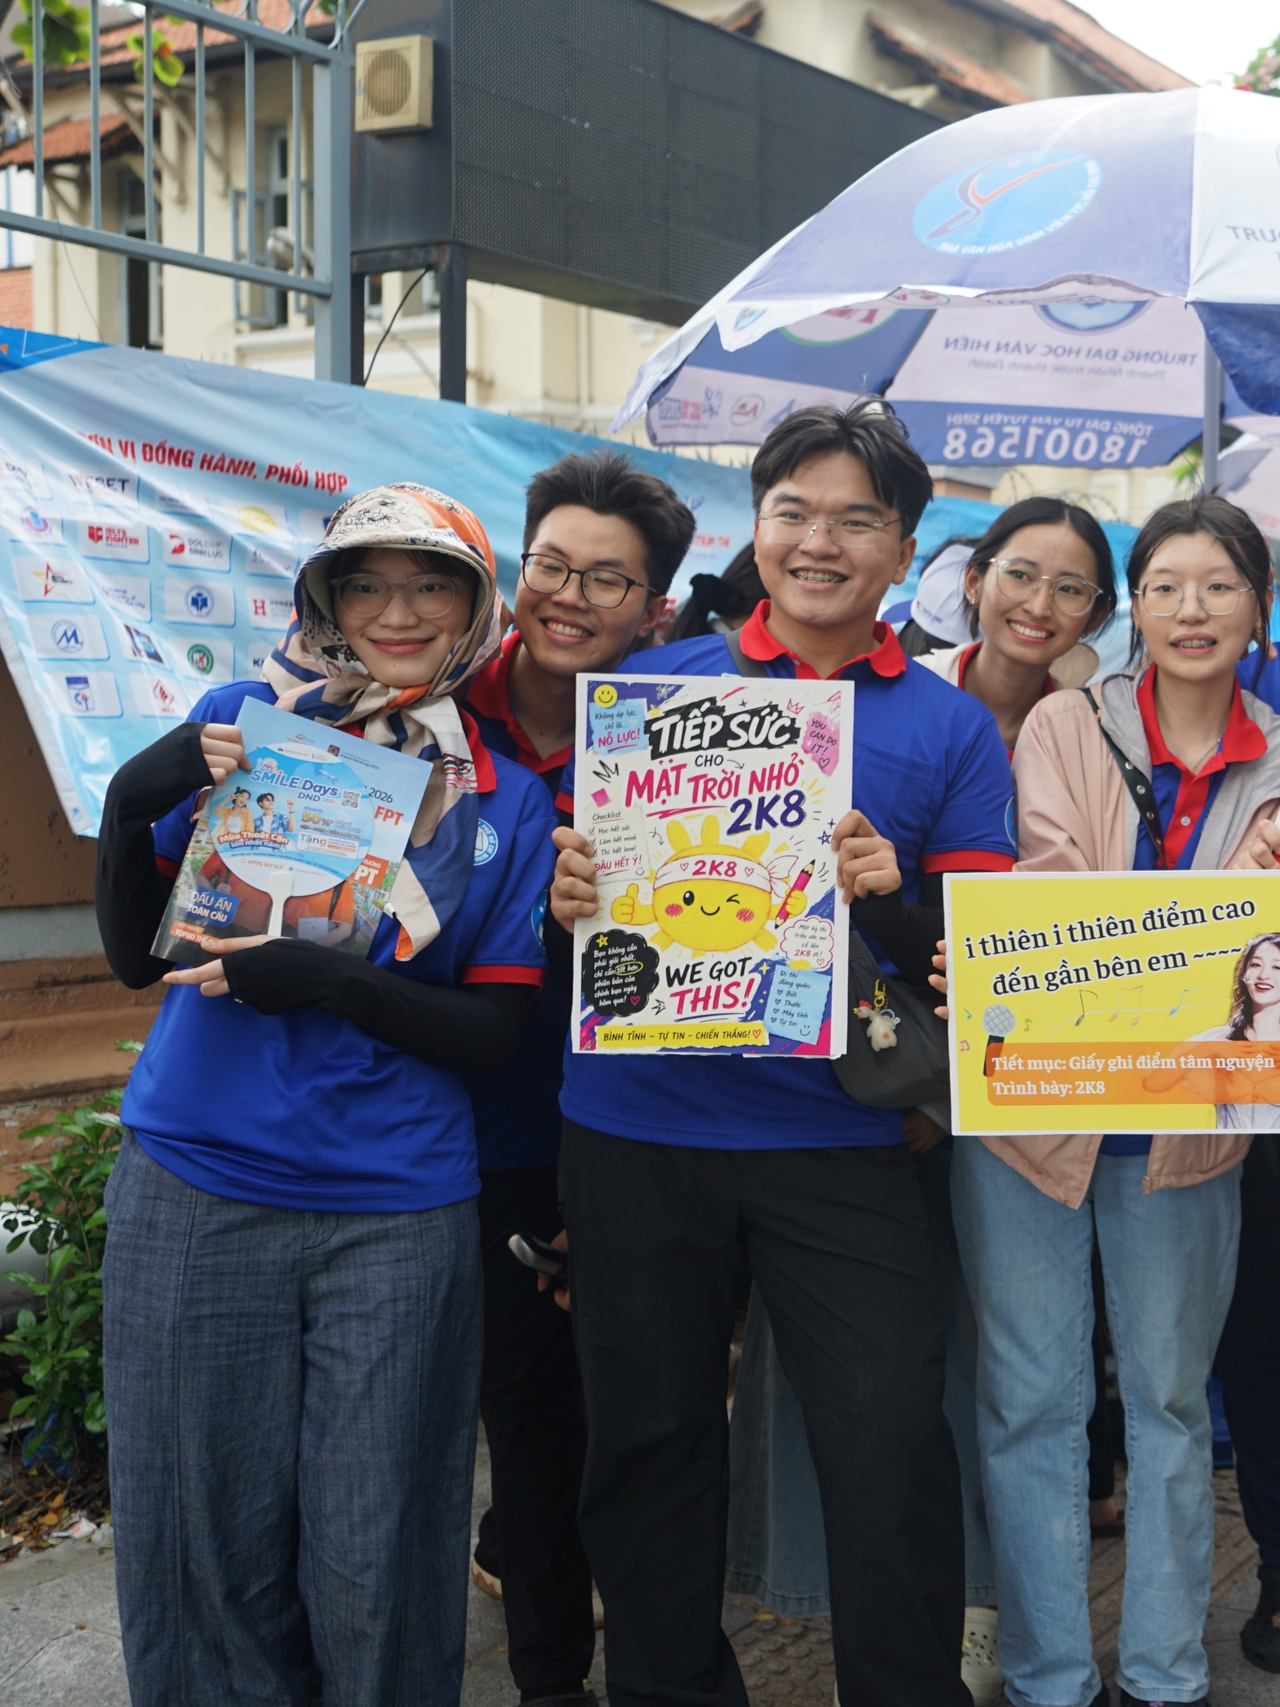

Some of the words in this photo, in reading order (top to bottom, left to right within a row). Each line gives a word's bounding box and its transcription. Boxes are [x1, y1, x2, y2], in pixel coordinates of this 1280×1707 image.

[313, 470, 348, 496] HỢP
[595, 712, 614, 720] Không
[615, 711, 624, 720] áp
[811, 718, 827, 730] YOU
[651, 701, 723, 753] TIẾP
[727, 707, 791, 748] SỨC
[598, 731, 614, 748] NỖ
[616, 727, 641, 744] LỰC!
[809, 730, 826, 741] CAN
[826, 736, 838, 746] DO
[810, 743, 829, 756] IT!
[694, 754, 724, 768] CHO
[368, 787, 394, 804] 2026
[687, 769, 741, 804] TRỜI
[374, 805, 404, 826] FPT
[592, 811, 621, 821] Checklist
[726, 789, 806, 836] 2K8
[219, 833, 241, 844] Mùa
[614, 855, 630, 868] HẾT
[691, 859, 737, 878] 2K8
[190, 891, 215, 907] DẤU
[214, 896, 233, 912] ẤN
[964, 936, 977, 960] i
[979, 926, 1050, 957] thiên
[1052, 922, 1064, 946] i
[1066, 914, 1137, 945] thiên
[1141, 899, 1208, 933] điểm
[1211, 899, 1256, 921] cao
[665, 961, 705, 988] WE
[709, 956, 753, 982] GOT
[991, 965, 1041, 997] đến
[1044, 958, 1091, 993] gần
[1093, 951, 1144, 981] bên
[1148, 950, 1190, 972] em
[669, 977, 756, 1015] THIS!
[603, 1029, 623, 1041] BÌNH
[626, 1029, 647, 1041] TĨNH
[658, 1030, 669, 1042] TỰ
[672, 1031, 685, 1040] TIN
[695, 1027, 721, 1040] CHIẾN
[722, 1027, 751, 1040] THẮNG!
[991, 1054, 1025, 1071] Tiết
[1026, 1057, 1066, 1075] mục:
[1068, 1052, 1106, 1074] Giấy
[1107, 1053, 1134, 1073] ghi
[1135, 1051, 1177, 1071] điểm
[1179, 1054, 1213, 1070] tâm
[1215, 1054, 1276, 1072] nguyện
[993, 1080, 1039, 1097] Trình
[1040, 1080, 1074, 1098] bày:
[1074, 1080, 1106, 1095] 2K8
